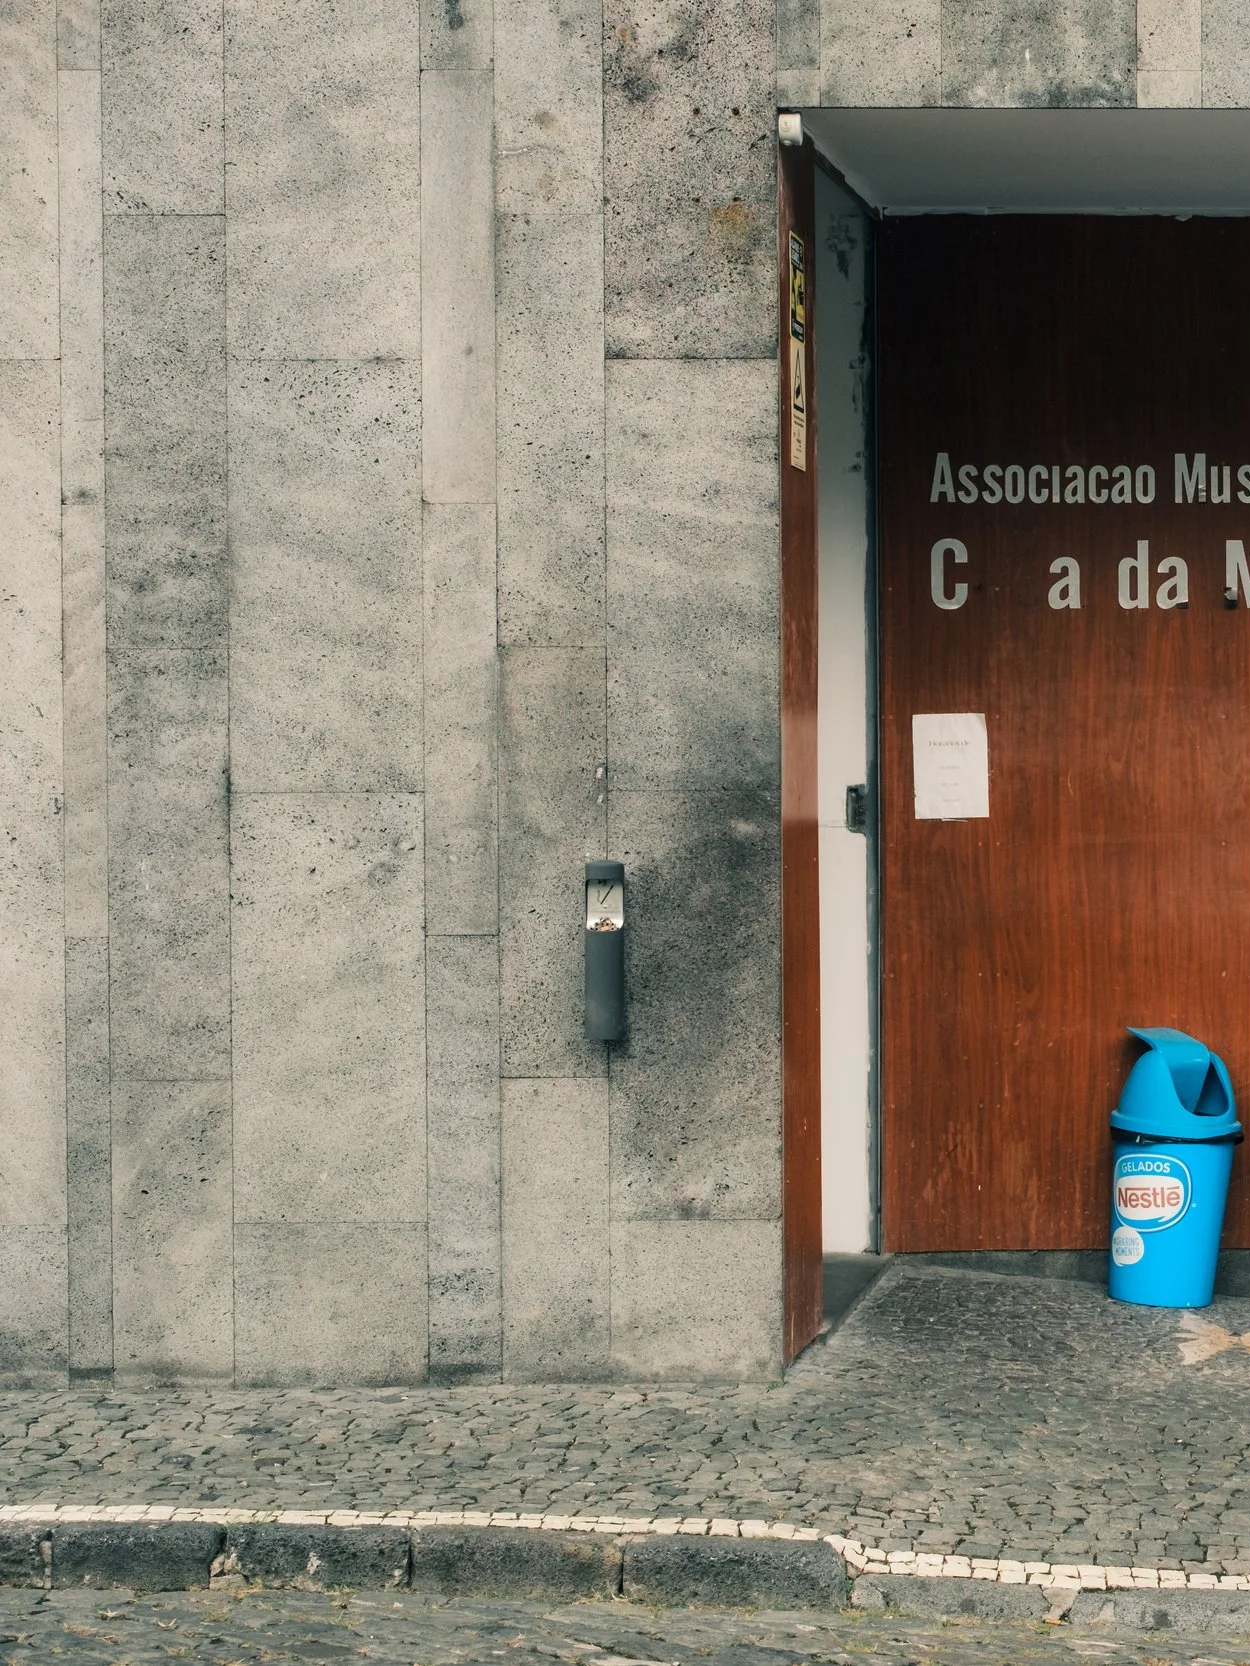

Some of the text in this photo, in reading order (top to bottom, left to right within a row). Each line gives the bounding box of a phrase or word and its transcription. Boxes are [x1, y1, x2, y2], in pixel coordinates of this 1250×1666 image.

[1117, 539, 1189, 610] da
[1121, 1161, 1171, 1174] GELADOS
[1118, 1186, 1181, 1209] Nestlé
